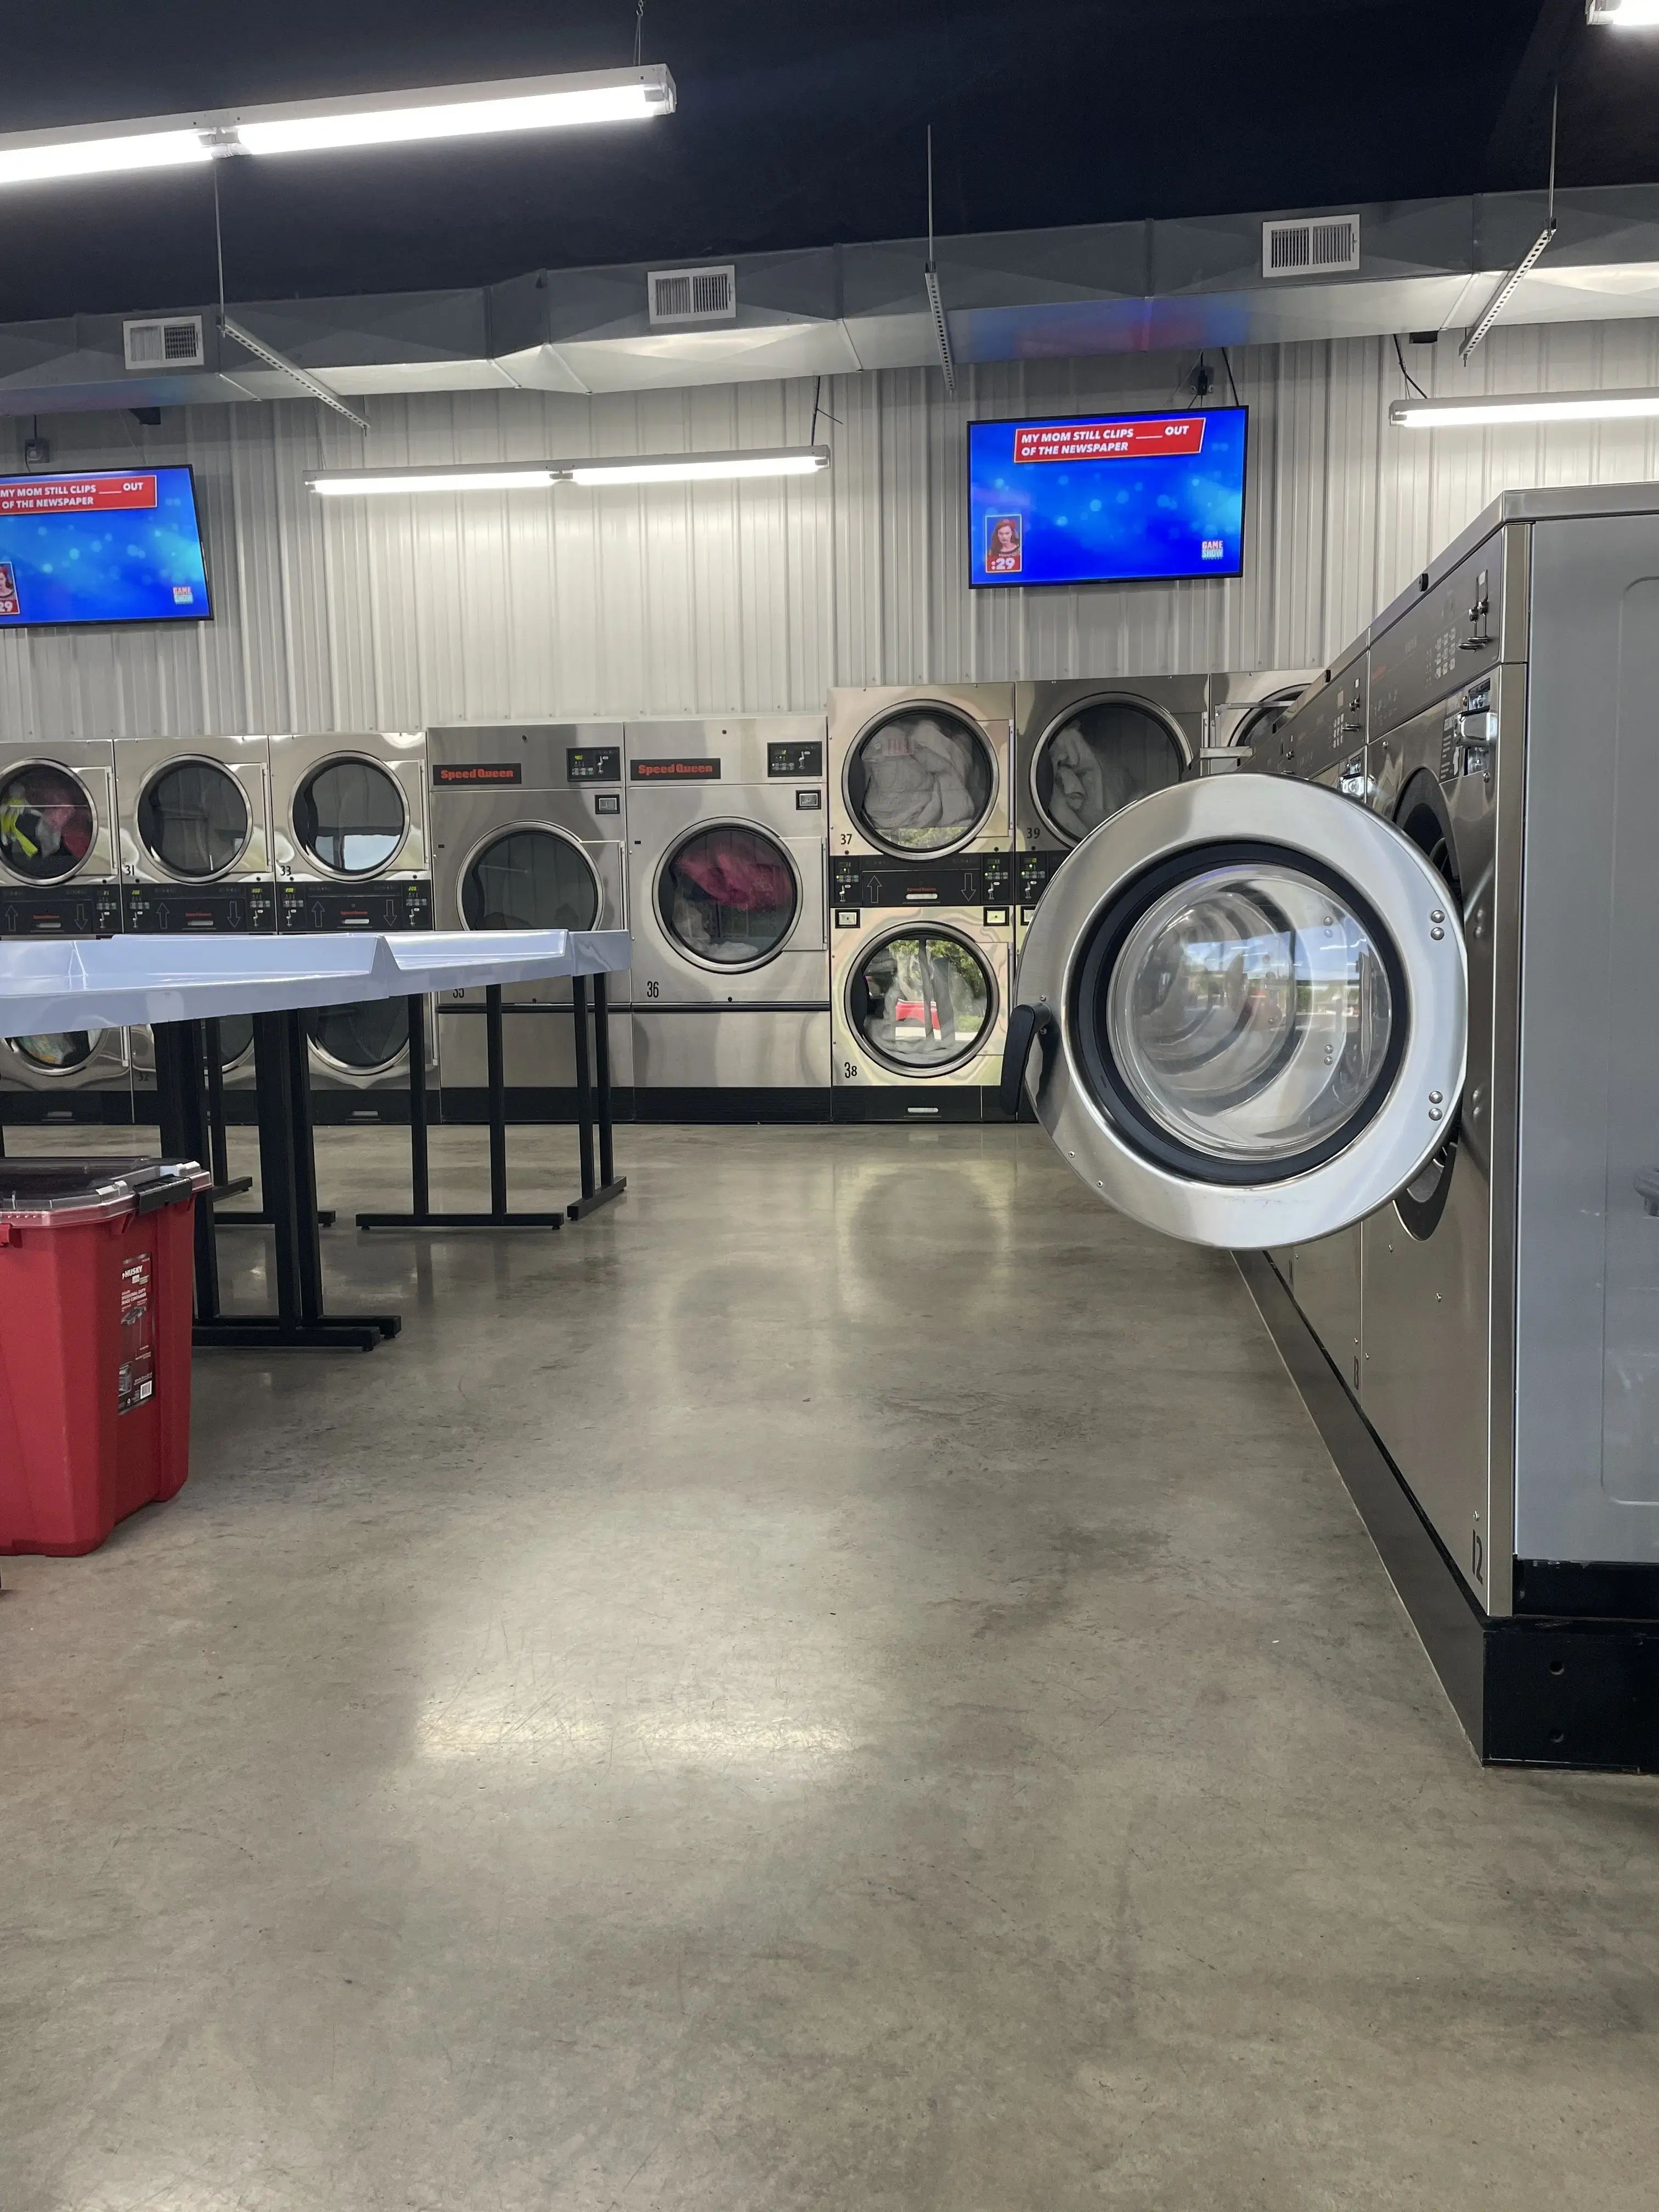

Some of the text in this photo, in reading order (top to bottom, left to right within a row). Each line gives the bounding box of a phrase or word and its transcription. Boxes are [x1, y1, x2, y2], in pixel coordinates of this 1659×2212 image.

[1021, 426, 1189, 443] MY MOM STILL CLIPS OUT
[1021, 442, 1128, 456] OF THE NEWSPAPER
[0, 482, 144, 498] MY MOM STILL CLIPS OUT
[2, 496, 94, 509] OF THE NEWSPAPER
[1202, 540, 1223, 549] GAME
[991, 557, 1015, 570] :29
[441, 769, 514, 781] Speed Queen
[638, 763, 713, 776] Speed Queen
[840, 833, 853, 845] 37
[1026, 827, 1040, 839] 39
[125, 865, 134, 876] 31
[280, 865, 291, 876] 33
[647, 980, 659, 998] 36
[844, 1062, 857, 1079] 38
[125, 1265, 143, 1278] HUSKY
[1472, 1528, 1483, 1585] 12
